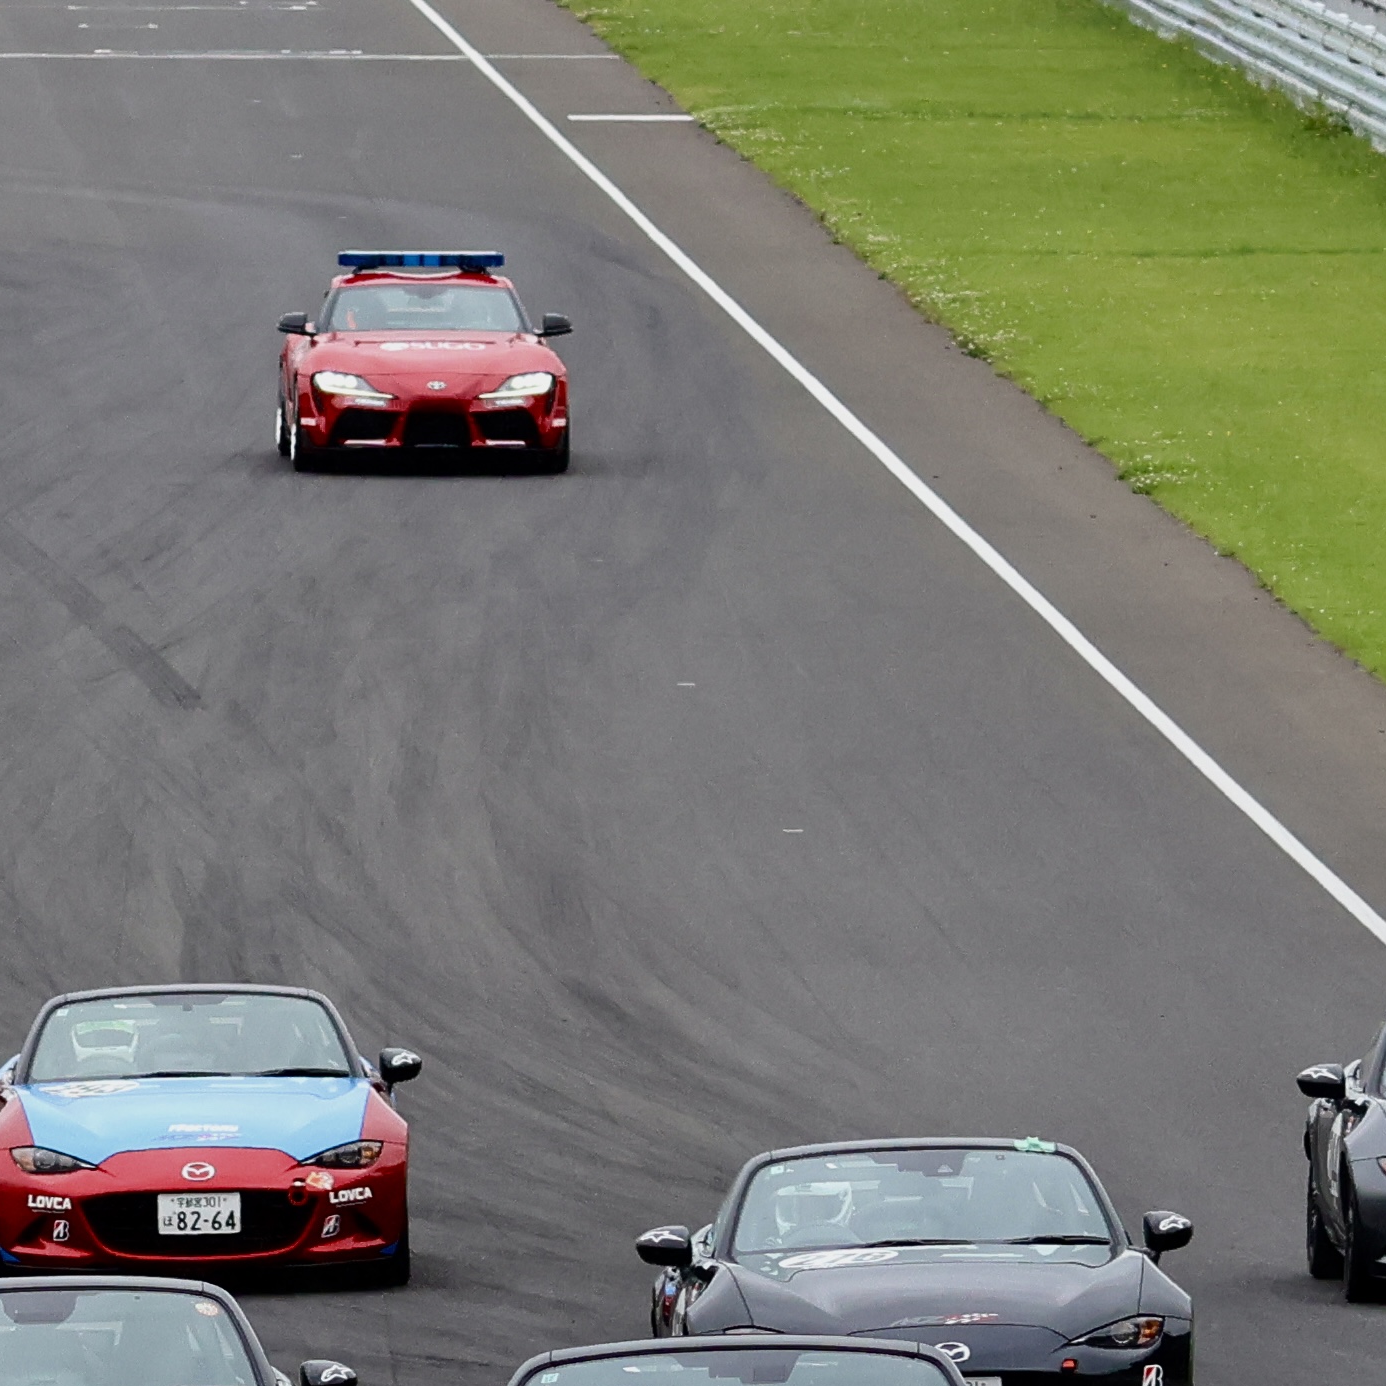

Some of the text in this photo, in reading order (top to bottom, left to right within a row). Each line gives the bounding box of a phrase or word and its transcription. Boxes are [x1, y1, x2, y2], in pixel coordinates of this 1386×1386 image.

[27, 1194, 72, 1209] LOVCA
[328, 1187, 373, 1203] LOVCA
[176, 1210, 237, 1231] 82-64
